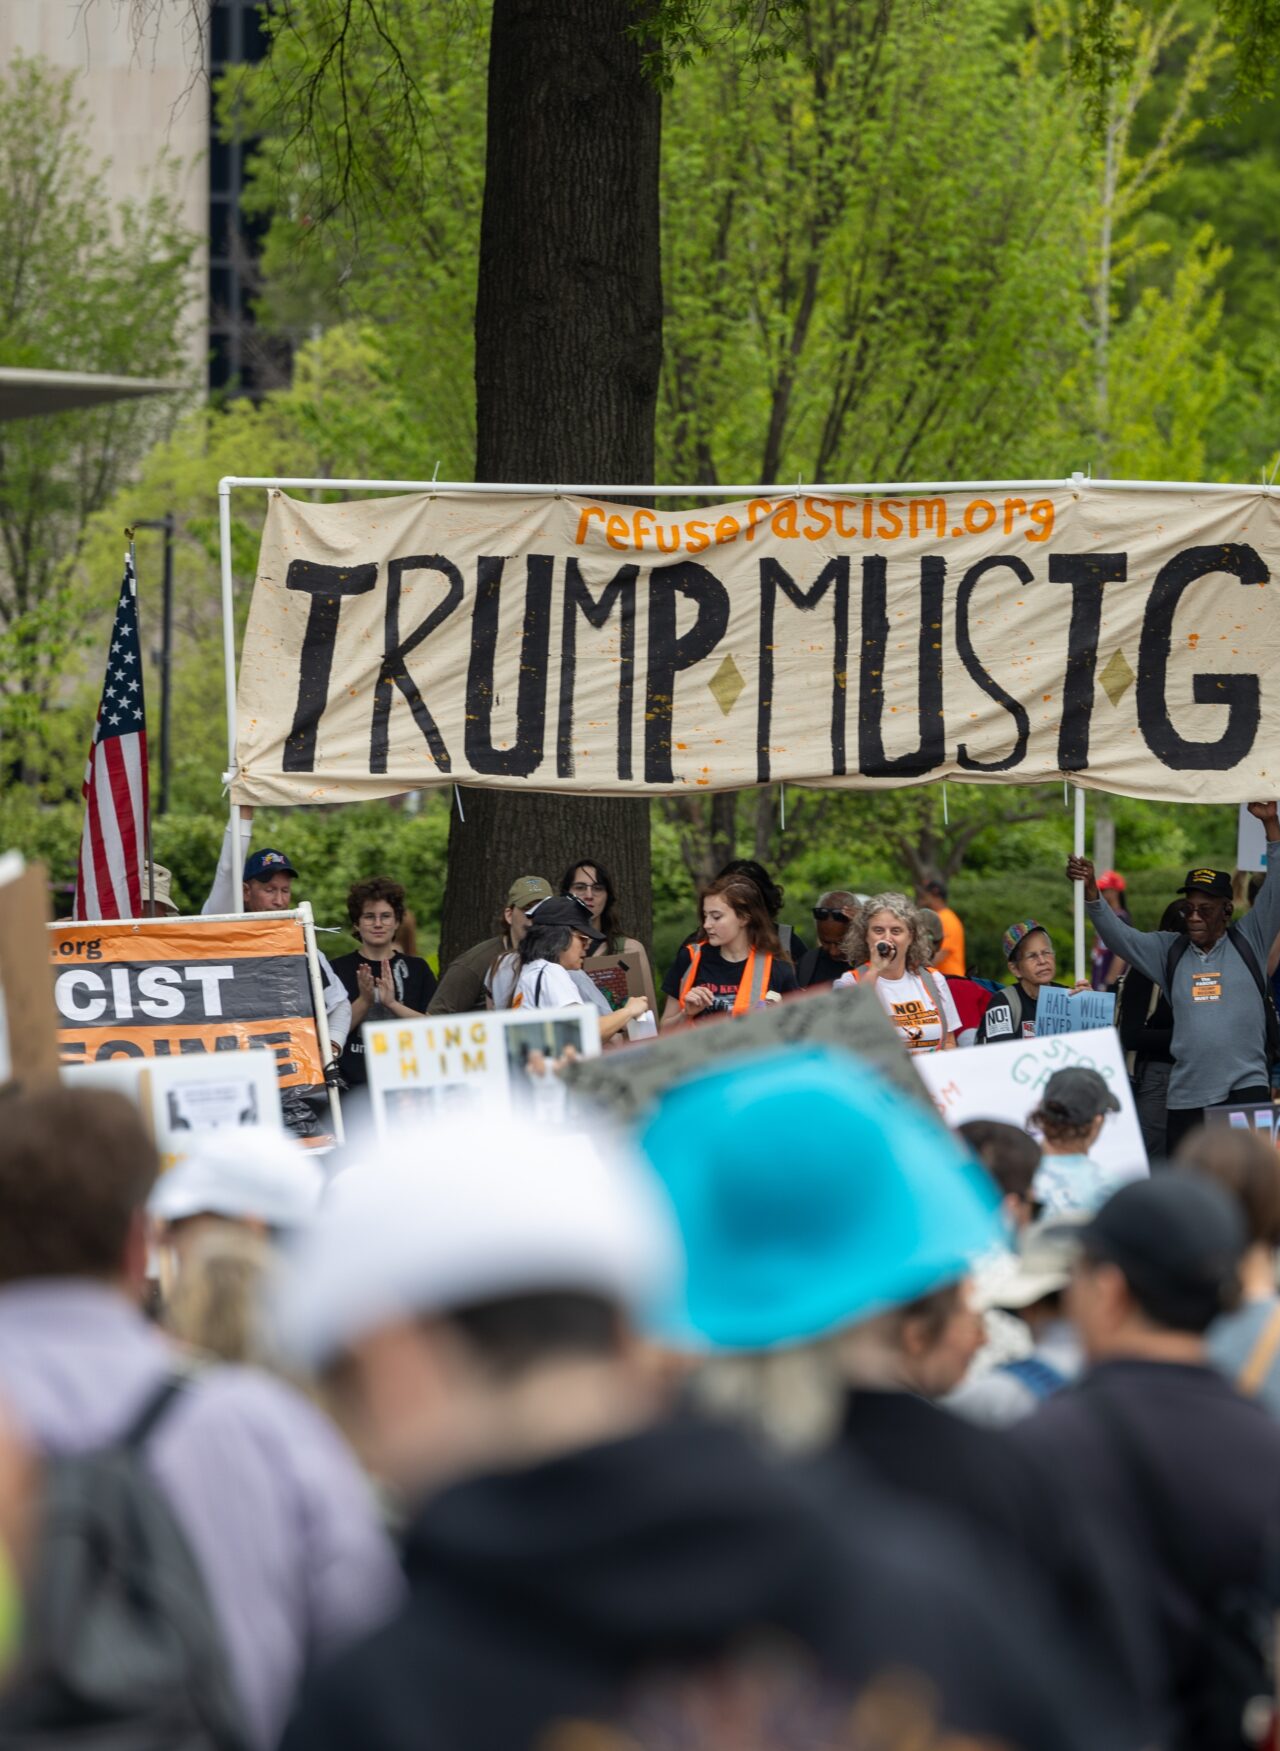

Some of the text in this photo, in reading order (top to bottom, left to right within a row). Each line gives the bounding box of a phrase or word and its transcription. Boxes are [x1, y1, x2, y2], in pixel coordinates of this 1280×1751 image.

[576, 497, 1056, 552] refusefascism.org
[282, 554, 730, 784] TRUMP
[757, 552, 1127, 783] MUST
[894, 1002, 922, 1015] NO!
[987, 1007, 1008, 1027] NO!
[1046, 993, 1106, 1020] HATE WILL
[1038, 1016, 1072, 1037] NEVER
[401, 1050, 487, 1079] HIM
